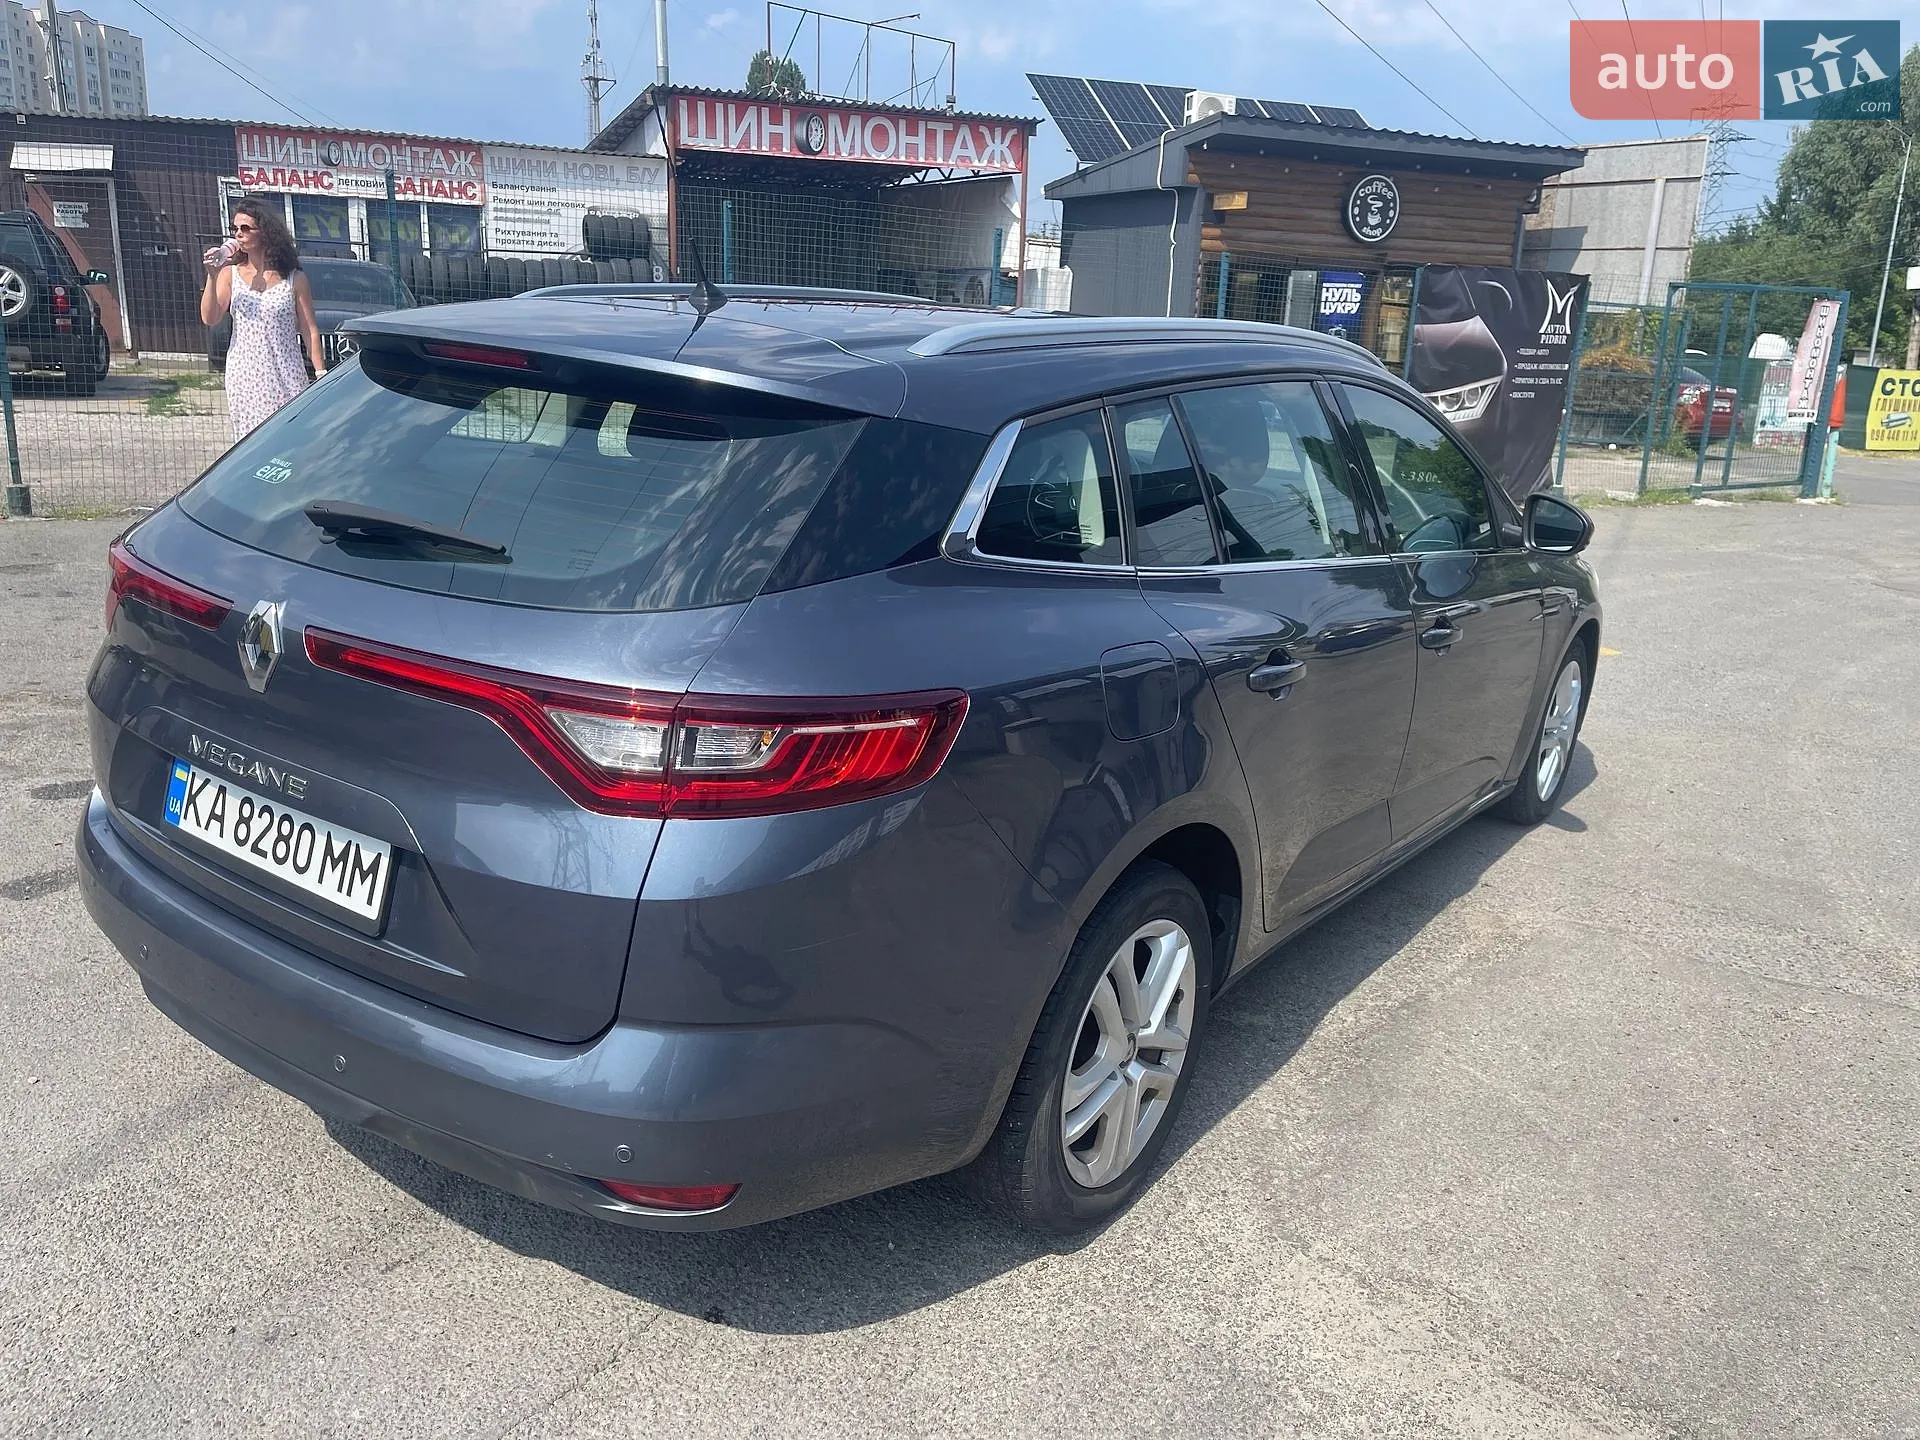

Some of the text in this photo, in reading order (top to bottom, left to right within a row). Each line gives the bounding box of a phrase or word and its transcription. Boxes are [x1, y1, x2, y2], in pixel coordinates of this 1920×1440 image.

[490, 156, 558, 179] ШИНИ
[626, 166, 660, 185] Б/У
[238, 166, 334, 190] БАЛАНС
[394, 176, 477, 200] БАЛАНС
[491, 181, 557, 193] Балансування
[1359, 180, 1394, 199] coffee
[492, 196, 525, 206] Ремонт
[526, 199, 546, 207] шин
[495, 227, 547, 239] Рихтування
[1361, 226, 1383, 237] shop
[537, 239, 566, 248] дисків
[1321, 287, 1361, 302] НУЛЬ
[1320, 301, 1360, 315] ЦУКРУ
[1545, 324, 1565, 334] AVTO
[1540, 334, 1567, 344] PIDBIR
[187, 734, 309, 801] MEGANE
[169, 796, 181, 816] UA
[233, 796, 316, 875] 8280
